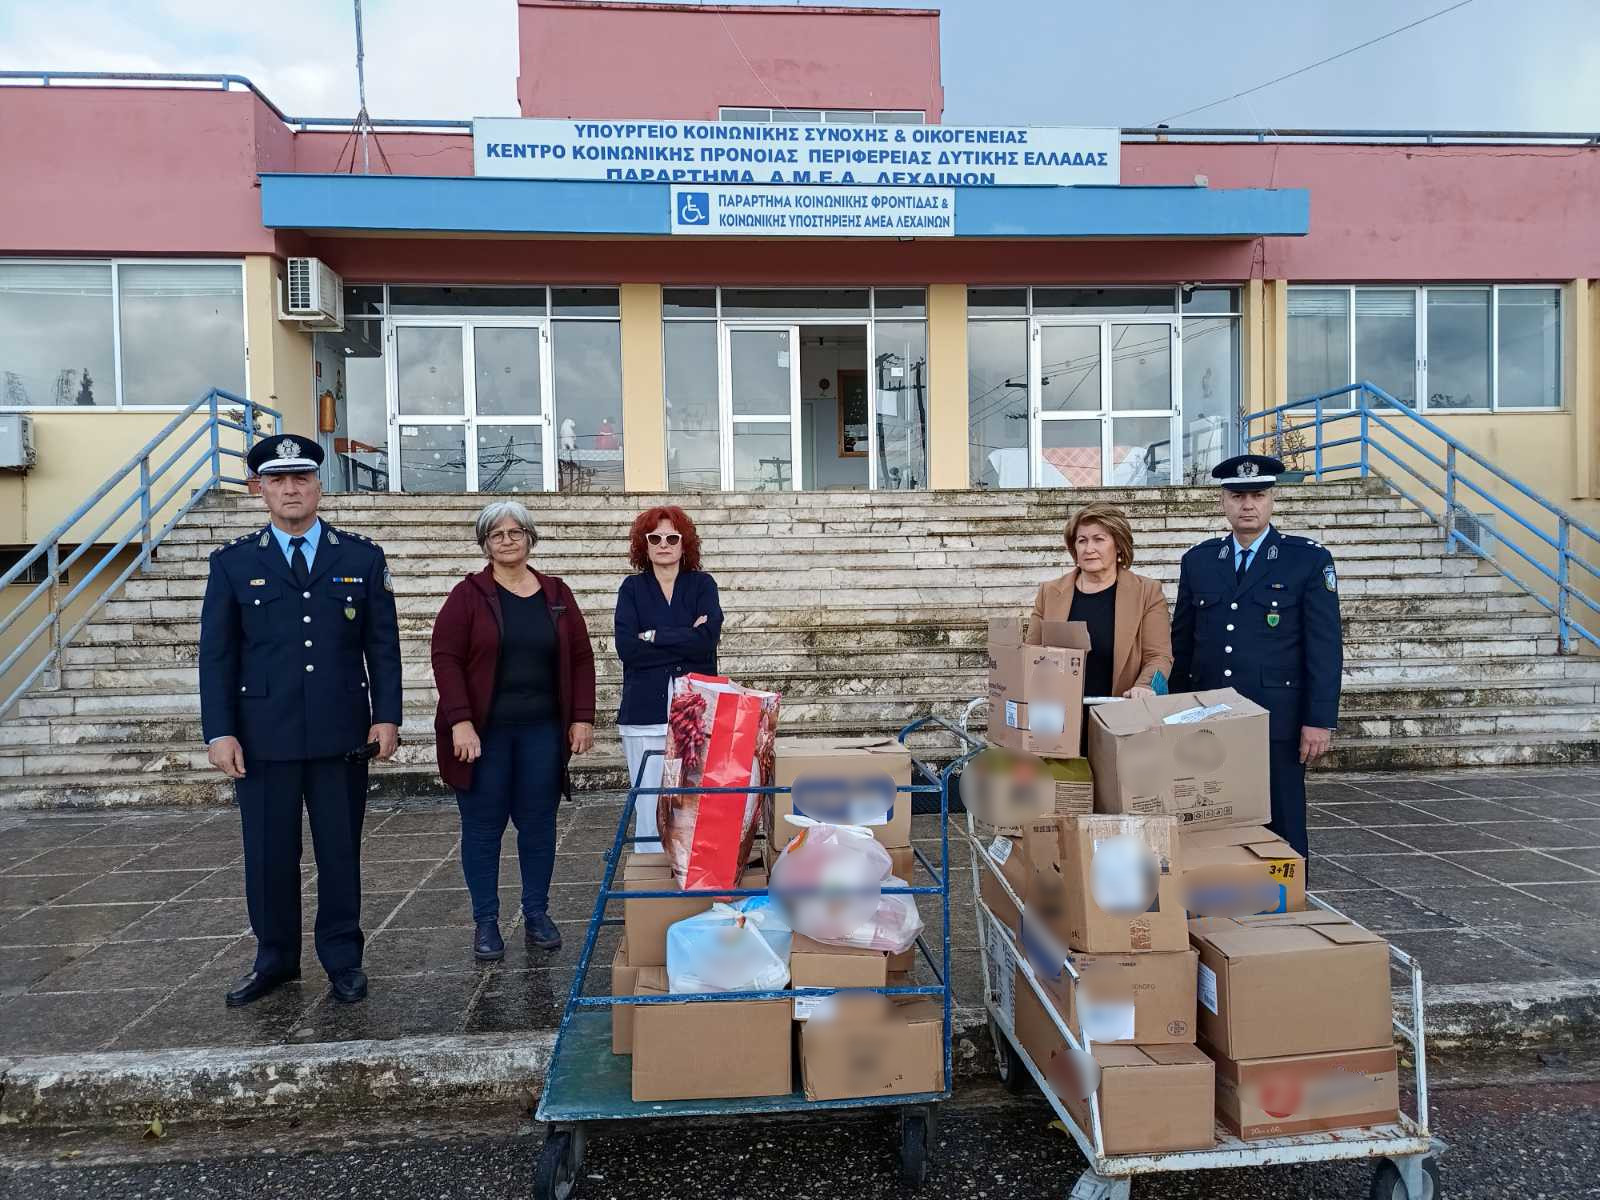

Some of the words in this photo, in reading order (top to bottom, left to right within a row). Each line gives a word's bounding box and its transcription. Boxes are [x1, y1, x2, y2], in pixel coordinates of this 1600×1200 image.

[574, 124, 678, 138] ΥΠΟΥΡΓΕΙΟ
[683, 125, 799, 141] ΚΟΙΝΩΝΙΚΗΣ
[805, 127, 888, 142] ΣΥΝΟΧΗΣ
[894, 128, 906, 143] &
[912, 129, 1028, 144] ΟΙΚΟΓΕΝΕΙΑΣ
[487, 143, 566, 159] ΚΕΝΤΡΟ
[572, 145, 695, 161] ΚΟΙΝΩΝΙΚΗΣ
[700, 147, 798, 163] ΠΡΟΝΟΙΑΣ
[808, 149, 931, 165] ΠΕΡΙΦΕΡΕΙΑΣ
[938, 151, 1018, 166] ΔΥΤΙΚΗΣ
[1024, 151, 1108, 166] ΕΛΛΑΔΑΣ
[718, 194, 792, 208] ΠΑΡΑΡΤΗΜΑ
[795, 195, 868, 209] ΚΟΙΝΩΝΙΚΗΣ
[871, 195, 939, 209] ΦΡΟΝΤΙΔΑΣ
[941, 198, 949, 209] &
[719, 213, 787, 227] ΚΟΙΝΩΝΙΚΗΣ
[789, 214, 862, 228] ΥΠΟΣΤΗΡΙΞΗΣ
[864, 215, 894, 228] ΑΜΕΑ
[896, 215, 950, 228] ΛΕΧΑΙΝΩΝ
